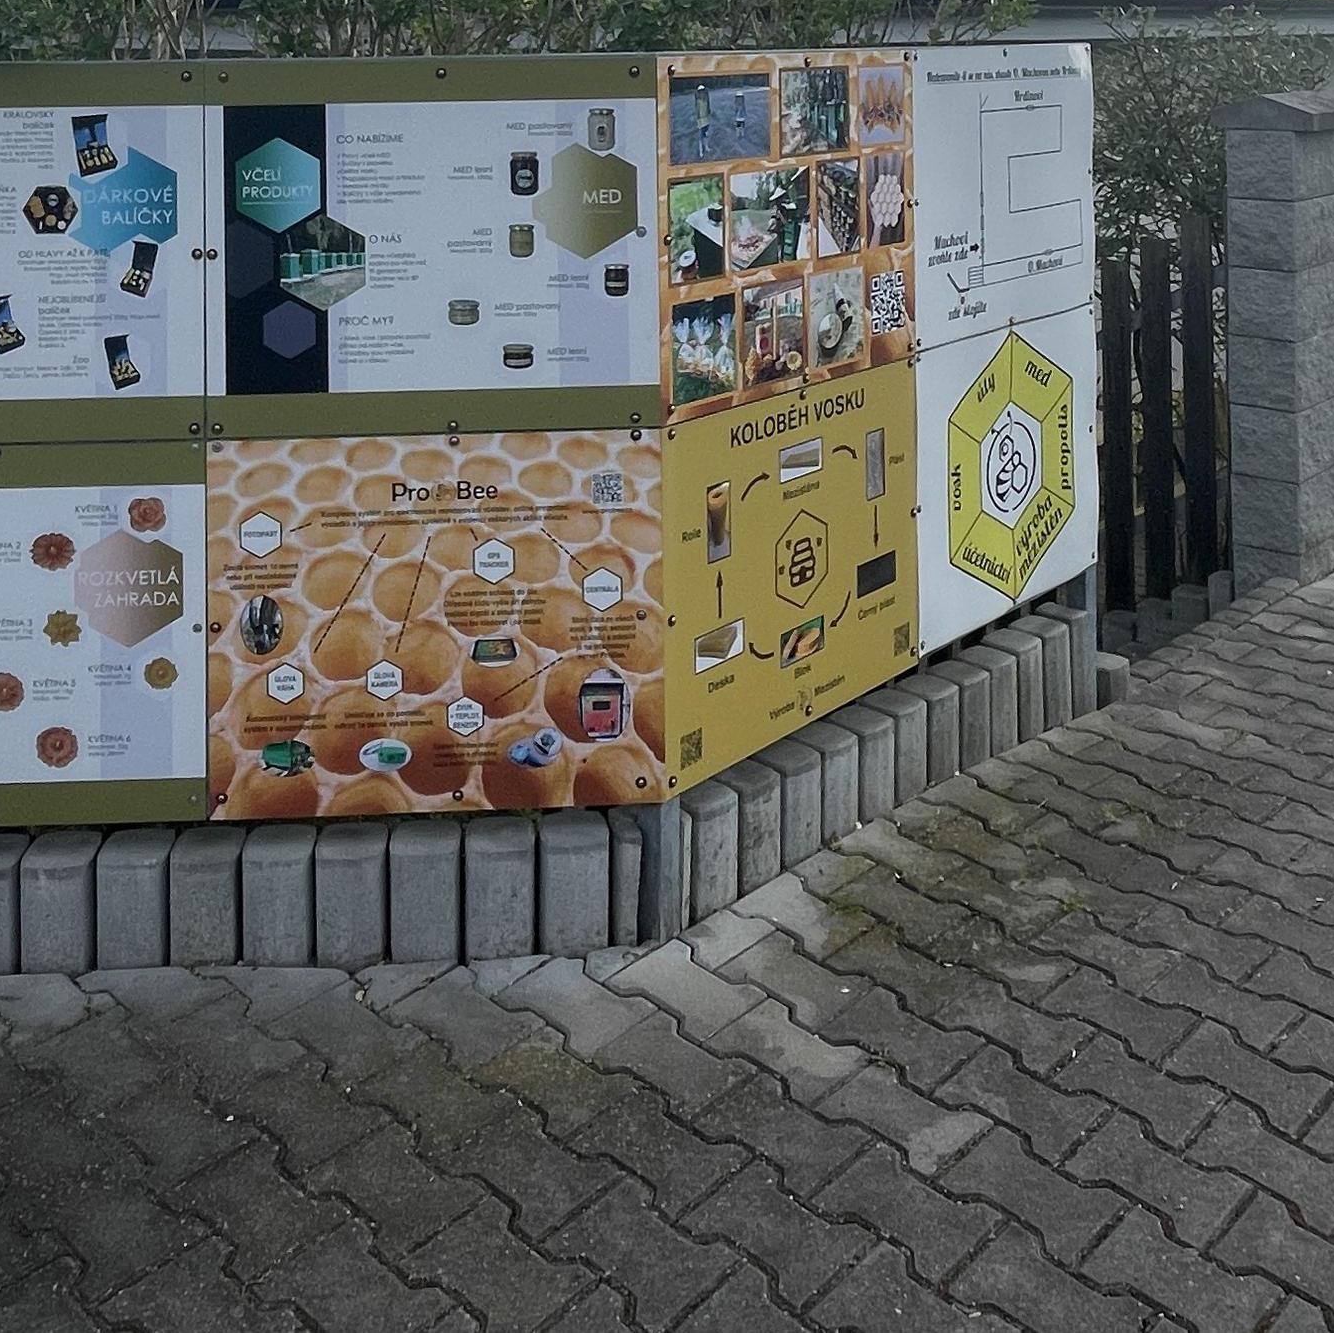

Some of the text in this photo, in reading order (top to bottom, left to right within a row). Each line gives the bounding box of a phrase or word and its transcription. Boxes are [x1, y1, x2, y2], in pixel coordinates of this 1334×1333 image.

[336, 133, 404, 144] CO NABÍZÍME
[242, 166, 281, 181] VČELÍ
[84, 186, 173, 203] DÁRKOVÉ
[242, 185, 313, 198] PRODUKTY
[583, 189, 622, 204] MED
[102, 207, 172, 225] BALÍČKY
[369, 233, 402, 244] O NÁS
[18, 250, 33, 258] OD
[35, 249, 64, 258] HLAVY
[67, 248, 78, 258] AŽ
[338, 316, 369, 326] PROČ
[1025, 361, 1052, 387] med
[976, 373, 995, 403] úly
[731, 388, 865, 448] KOLOBĚH VOSKU
[1058, 404, 1072, 490] propolis
[392, 481, 498, 502] Pro Bee
[951, 464, 961, 510] vosk
[75, 504, 110, 513] KVĚTINA
[1016, 495, 1052, 556] výroba
[78, 566, 180, 587] ROZKVETLÁ
[94, 591, 179, 608] ZAHRADA
[32, 678, 68, 687] KVĚTINA
[708, 673, 735, 694] Deska
[88, 734, 124, 743] KVĚTINA
